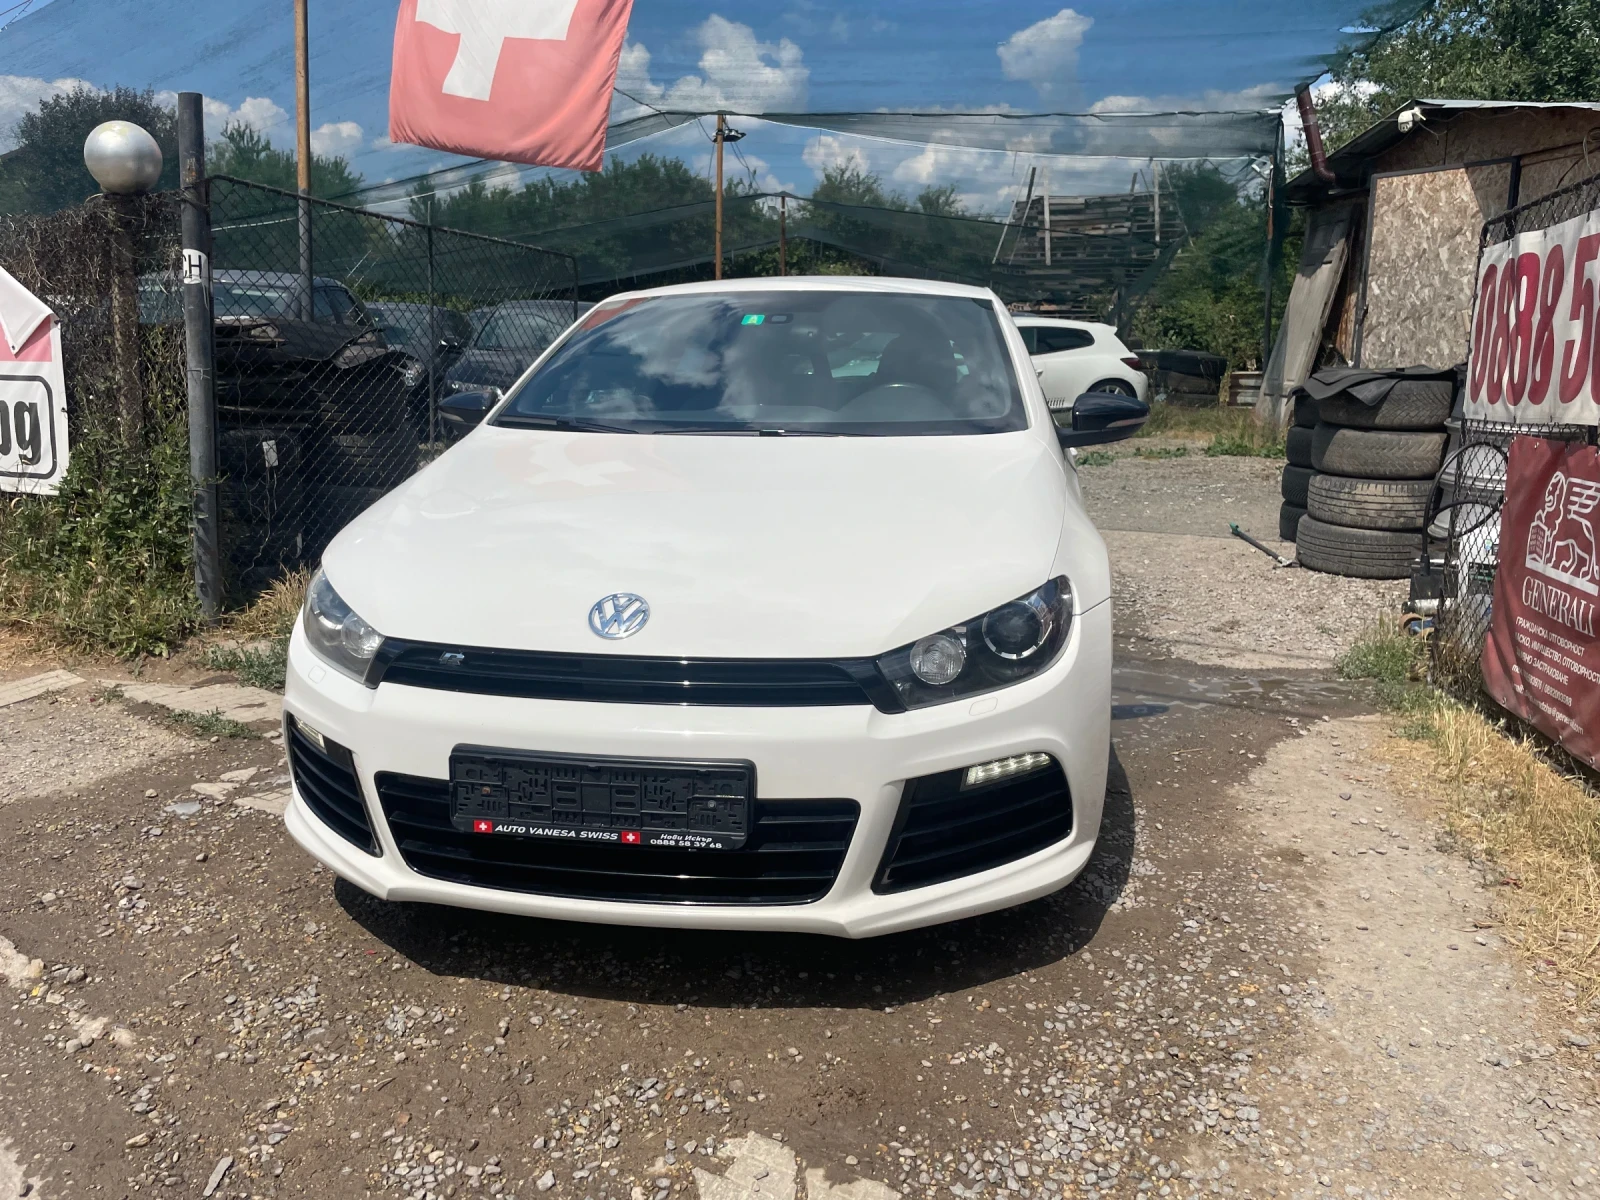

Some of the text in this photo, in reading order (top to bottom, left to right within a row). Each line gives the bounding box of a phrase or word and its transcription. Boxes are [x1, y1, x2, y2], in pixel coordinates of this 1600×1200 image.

[1559, 233, 1600, 405] 5
[1522, 576, 1596, 638] GENERALI
[1516, 616, 1549, 639] ГРАЖДАНСКА
[1548, 632, 1585, 657] ОТГОВОРНОСТ
[495, 824, 619, 840] AUTO VANESA SWISS
[650, 838, 676, 846] 0888
[660, 833, 713, 843] Нови Искър
